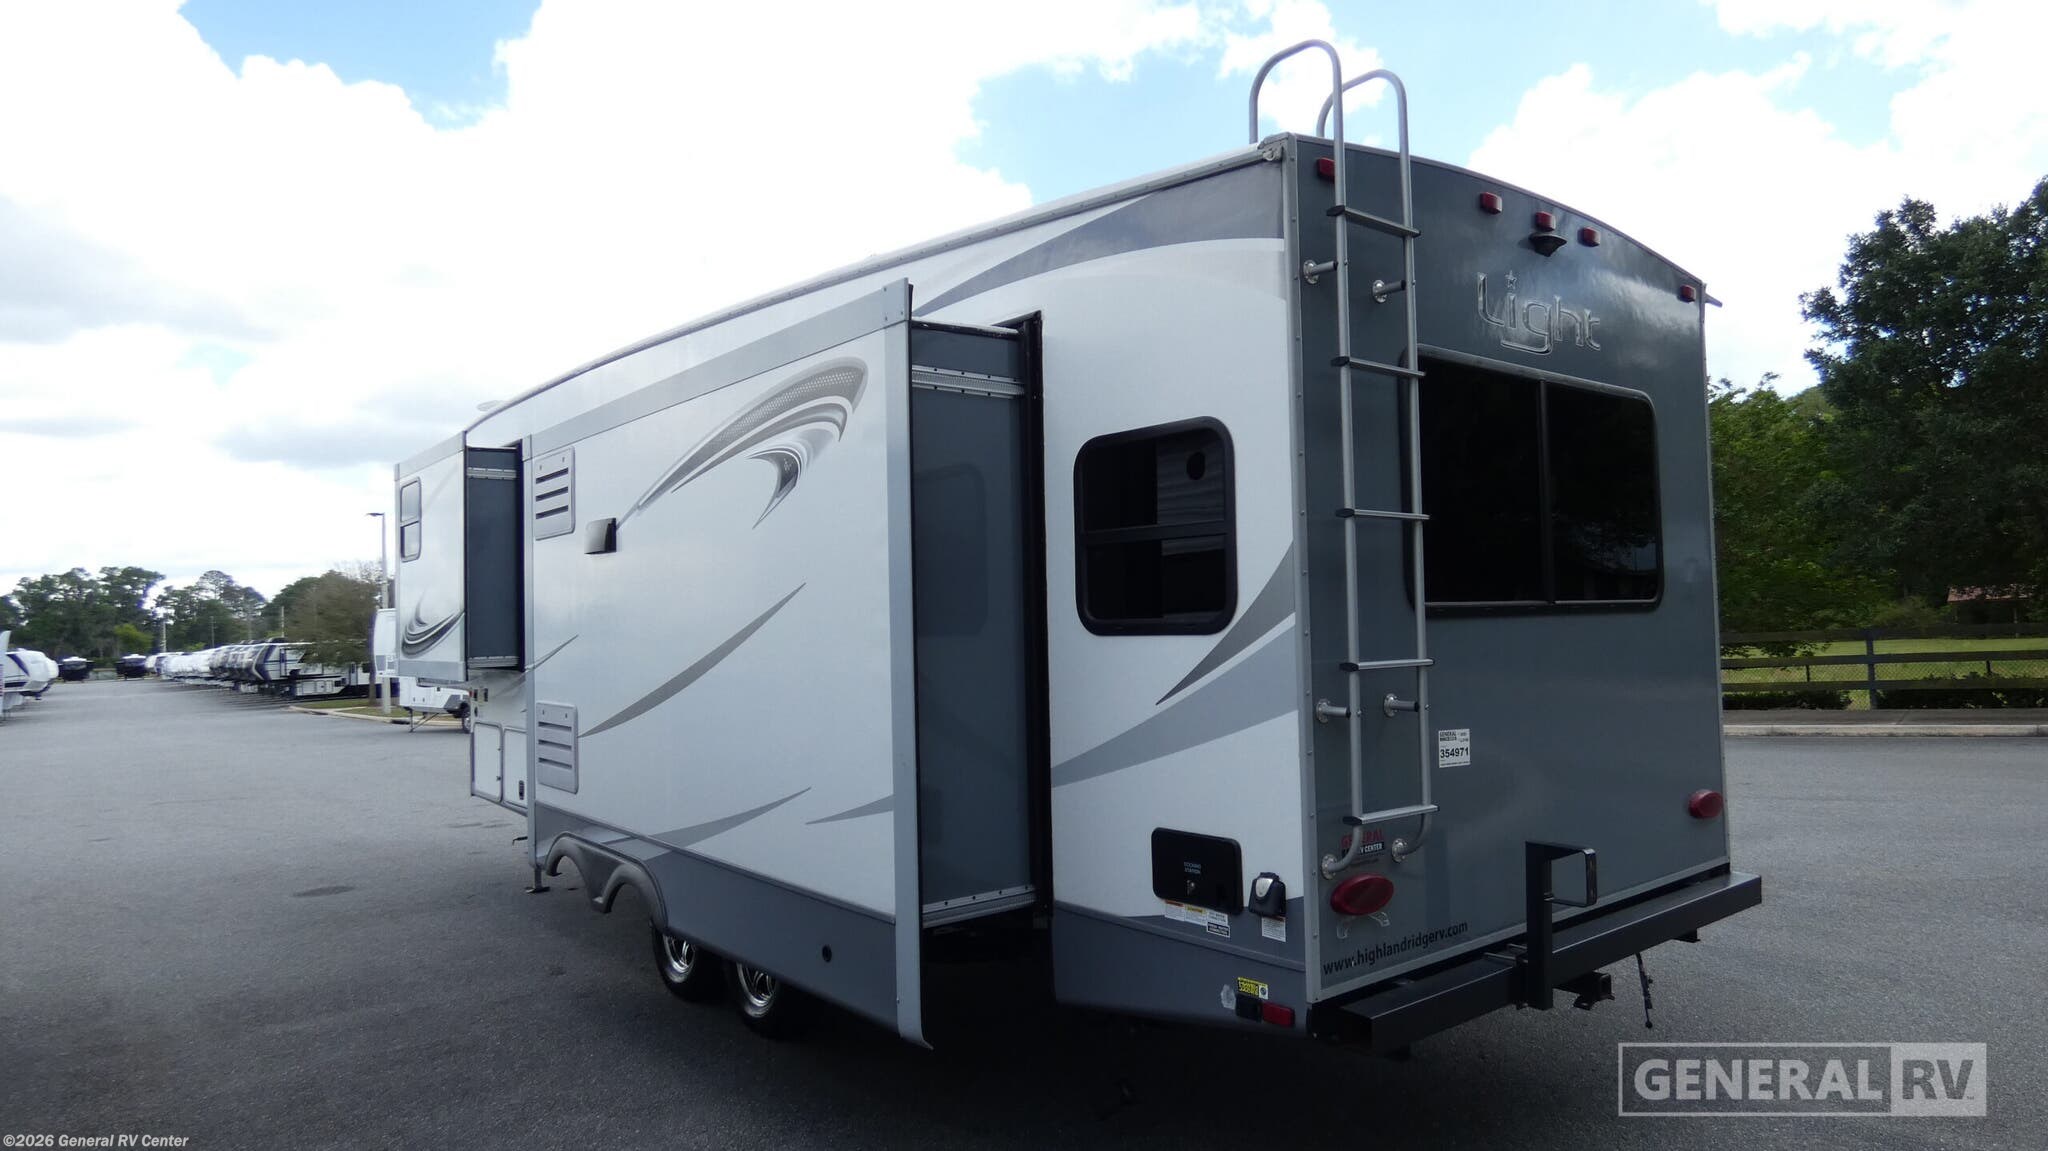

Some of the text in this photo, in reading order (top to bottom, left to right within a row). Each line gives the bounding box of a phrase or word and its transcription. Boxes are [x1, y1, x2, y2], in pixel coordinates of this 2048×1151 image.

[1477, 271, 1600, 355] Light
[1440, 747, 1469, 758] 354971
[1323, 921, 1468, 975] www.highlandridgerv.com
